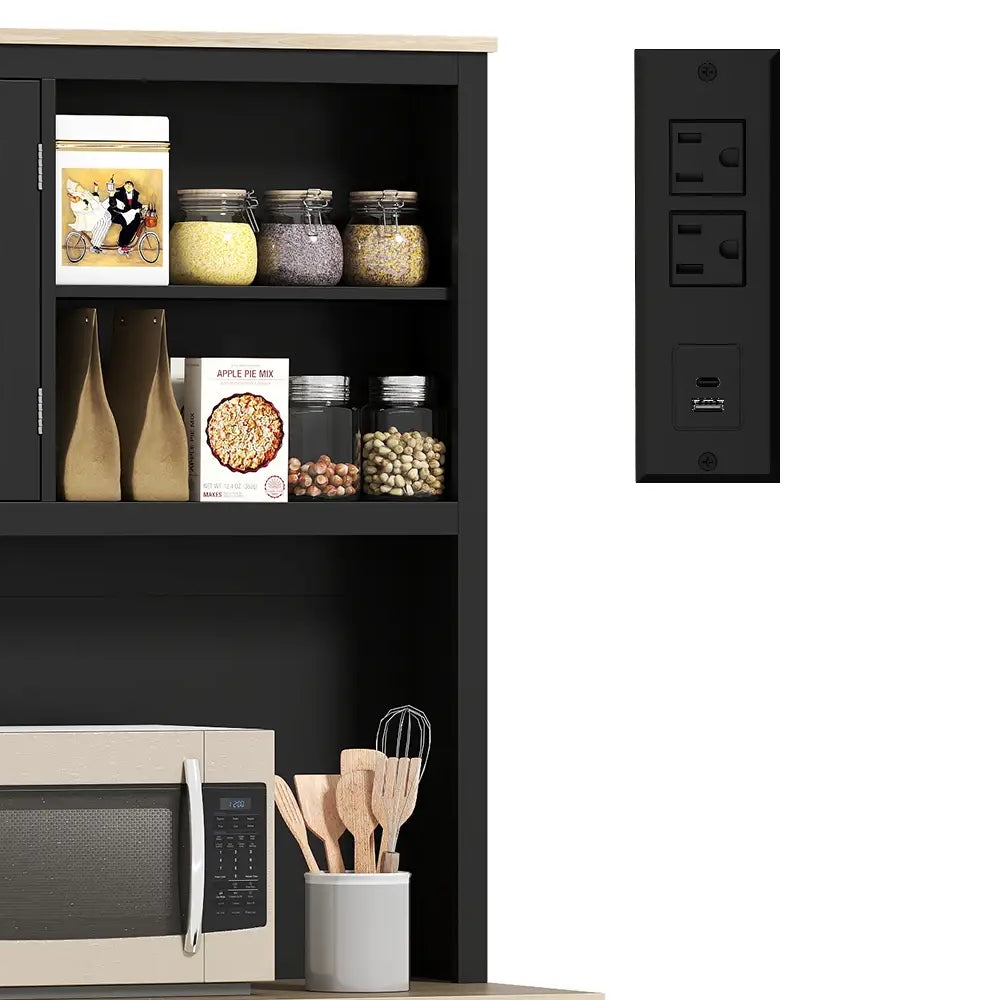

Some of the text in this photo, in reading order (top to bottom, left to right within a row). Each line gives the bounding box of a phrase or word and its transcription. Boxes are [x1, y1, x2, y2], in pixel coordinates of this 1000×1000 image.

[216, 369, 274, 378] APPLE PIE MIX
